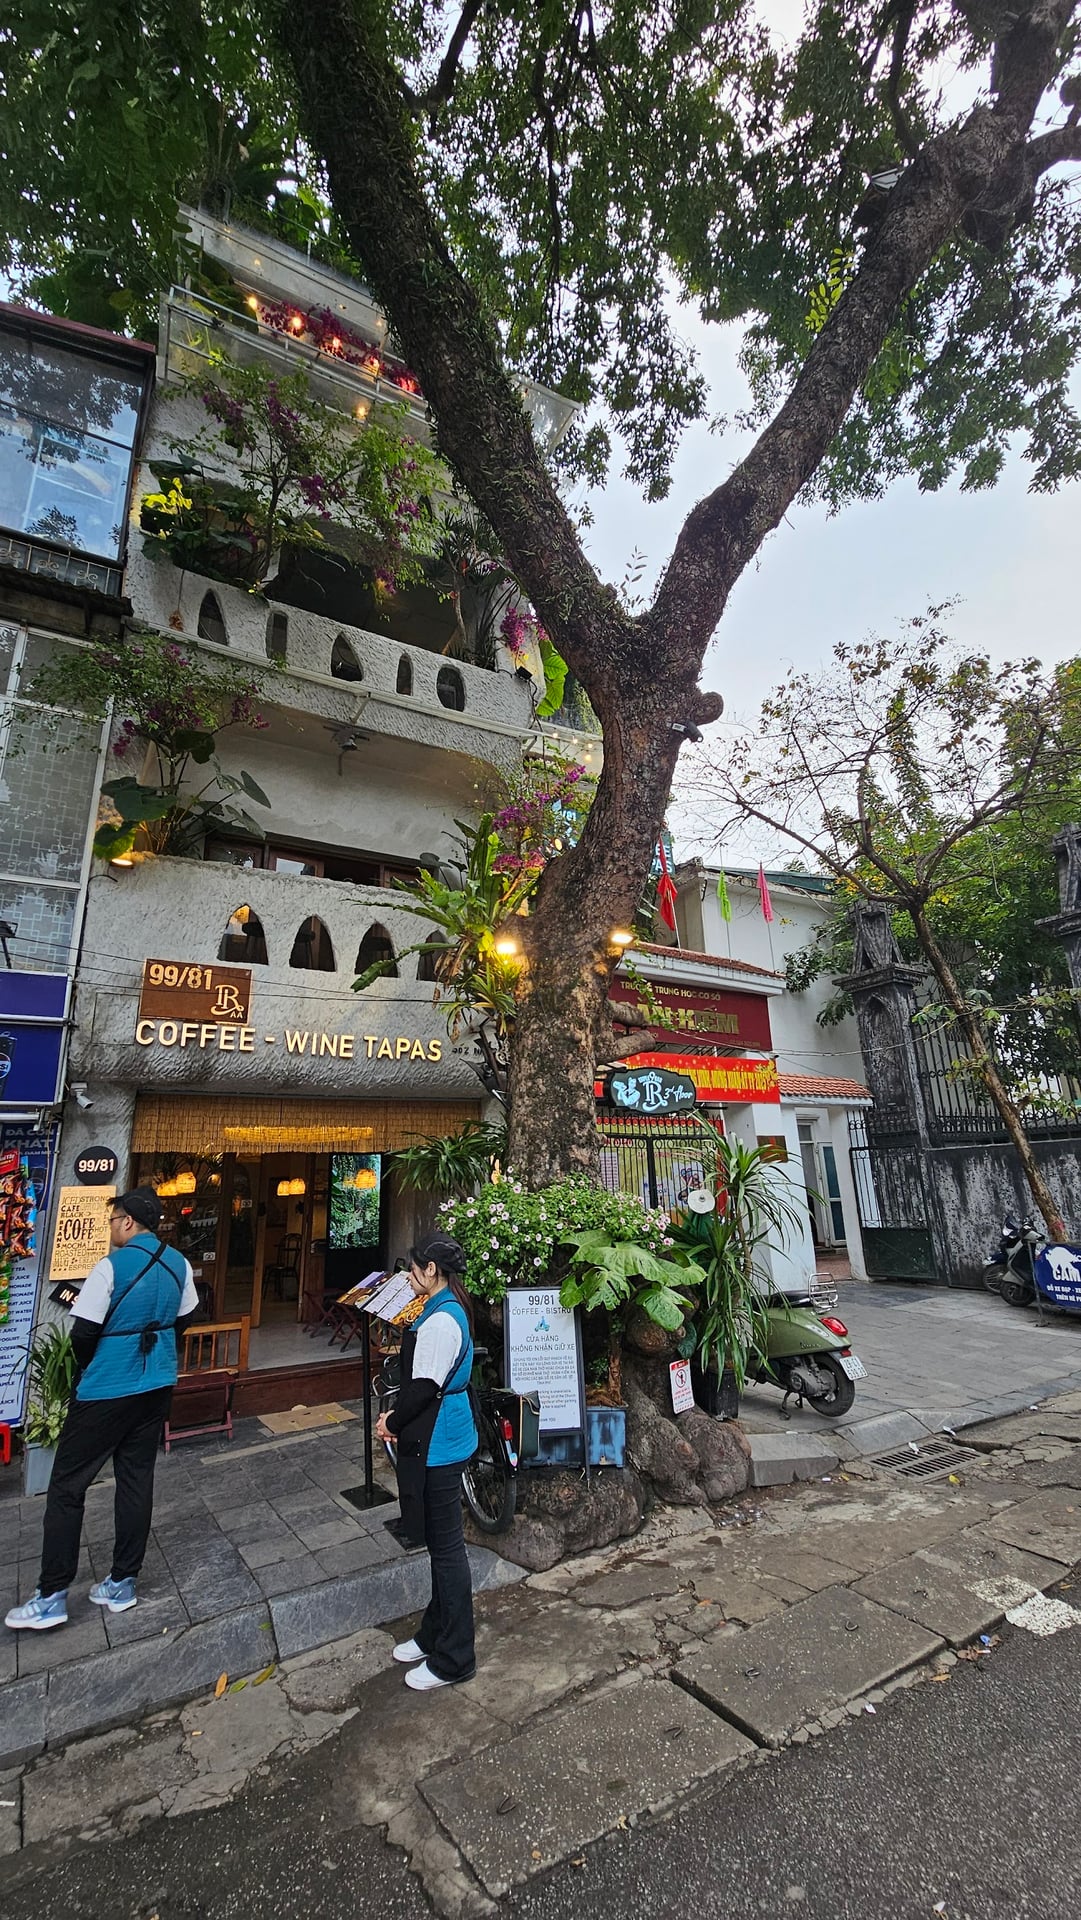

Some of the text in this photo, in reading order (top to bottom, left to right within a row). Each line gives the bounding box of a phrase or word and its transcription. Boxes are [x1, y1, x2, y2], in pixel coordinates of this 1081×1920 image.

[149, 963, 213, 991] 99/81
[655, 985, 680, 996] TRUNG
[135, 1020, 256, 1052] COFFEE
[285, 1029, 355, 1059] WINE
[363, 1035, 443, 1063] TAPAS
[673, 1084, 693, 1103] floor
[78, 1158, 115, 1172] 99/81
[62, 1242, 87, 1250] MOCHA
[55, 1249, 87, 1258] ROASTED
[68, 1263, 96, 1271] ESPRES
[59, 1288, 73, 1302] IN
[528, 1294, 555, 1306] 99/81
[511, 1307, 539, 1316] COFFEE
[541, 1333, 559, 1342] HÀNG
[511, 1343, 533, 1352] KHÔNG
